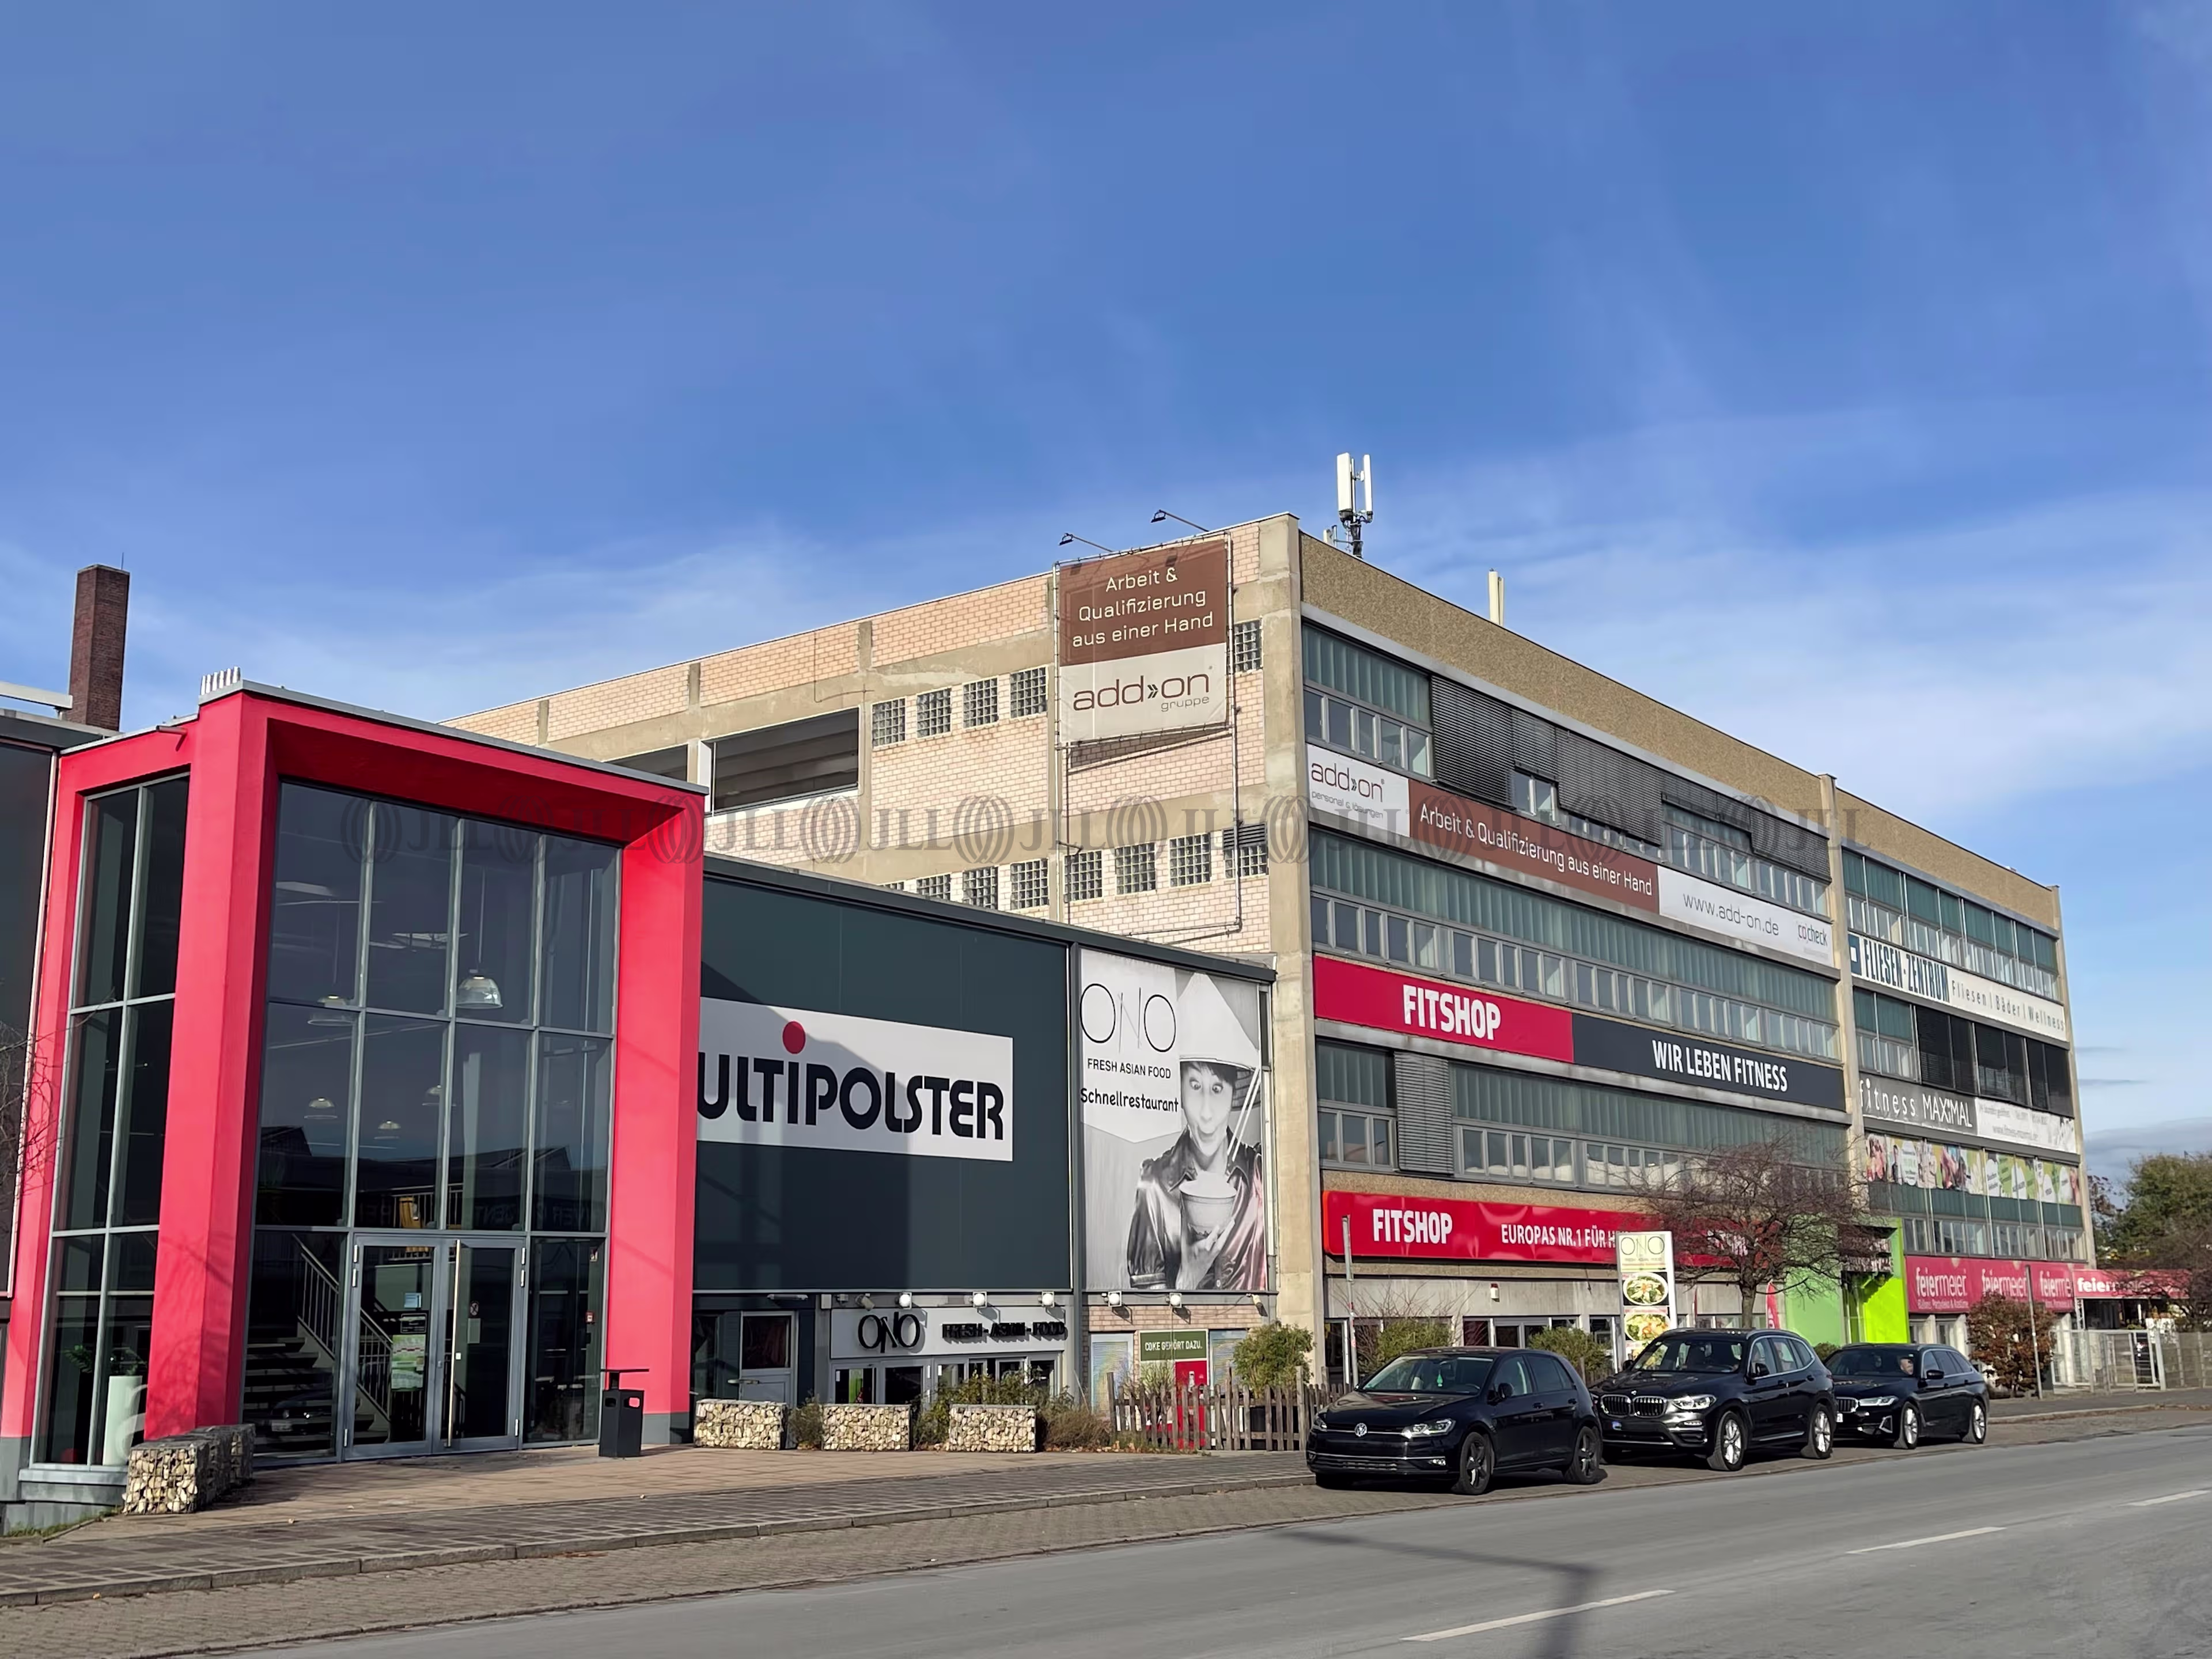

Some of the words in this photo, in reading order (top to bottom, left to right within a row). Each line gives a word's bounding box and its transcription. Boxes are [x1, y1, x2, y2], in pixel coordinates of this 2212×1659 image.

[1105, 570, 1160, 592] Arbeit
[1165, 567, 1178, 581] &
[1078, 590, 1206, 622] Qualifizierung
[1072, 631, 1105, 647] aus
[1112, 623, 1158, 642] einer
[1165, 611, 1213, 634] Hand
[1161, 696, 1210, 713] gruppe
[1311, 790, 1344, 807] personal
[1352, 802, 1384, 819] lösungen
[1420, 803, 1462, 835] Arbeit
[1465, 819, 1475, 839] &
[1478, 822, 1565, 872] Qualifizierung
[1567, 856, 1589, 876] aus
[1592, 862, 1621, 885] einer
[1623, 870, 1652, 896] Hand
[1682, 892, 1779, 936] www.add-on.de
[1080, 983, 1176, 1053] ONO
[1403, 984, 1501, 1040] FITSHOP
[1952, 980, 1987, 1006] Fliesen
[1995, 995, 2021, 1017] Bäder
[2028, 1005, 2065, 1032] Wellness
[698, 1021, 1003, 1141] ULTIPOLSTER
[1087, 1058, 1118, 1073] FRESH
[1119, 1062, 1146, 1076] ASIAN
[1148, 1066, 1171, 1080] FOOD
[1652, 1039, 1684, 1073] WIR
[1685, 1047, 1732, 1082] LEBEN
[1733, 1056, 1788, 1092] FITNESS
[1080, 1087, 1179, 1112] Schnellrestaurant
[1859, 1078, 1916, 1117] fitness
[1372, 1209, 1453, 1245] FITSHOP
[1501, 1224, 1555, 1246] EUROPAS
[1584, 1224, 1606, 1248] FÜR
[1915, 1266, 1968, 1297] feiermeier
[1145, 1341, 1161, 1351] COKE
[1185, 1340, 1203, 1350] DAZU.
